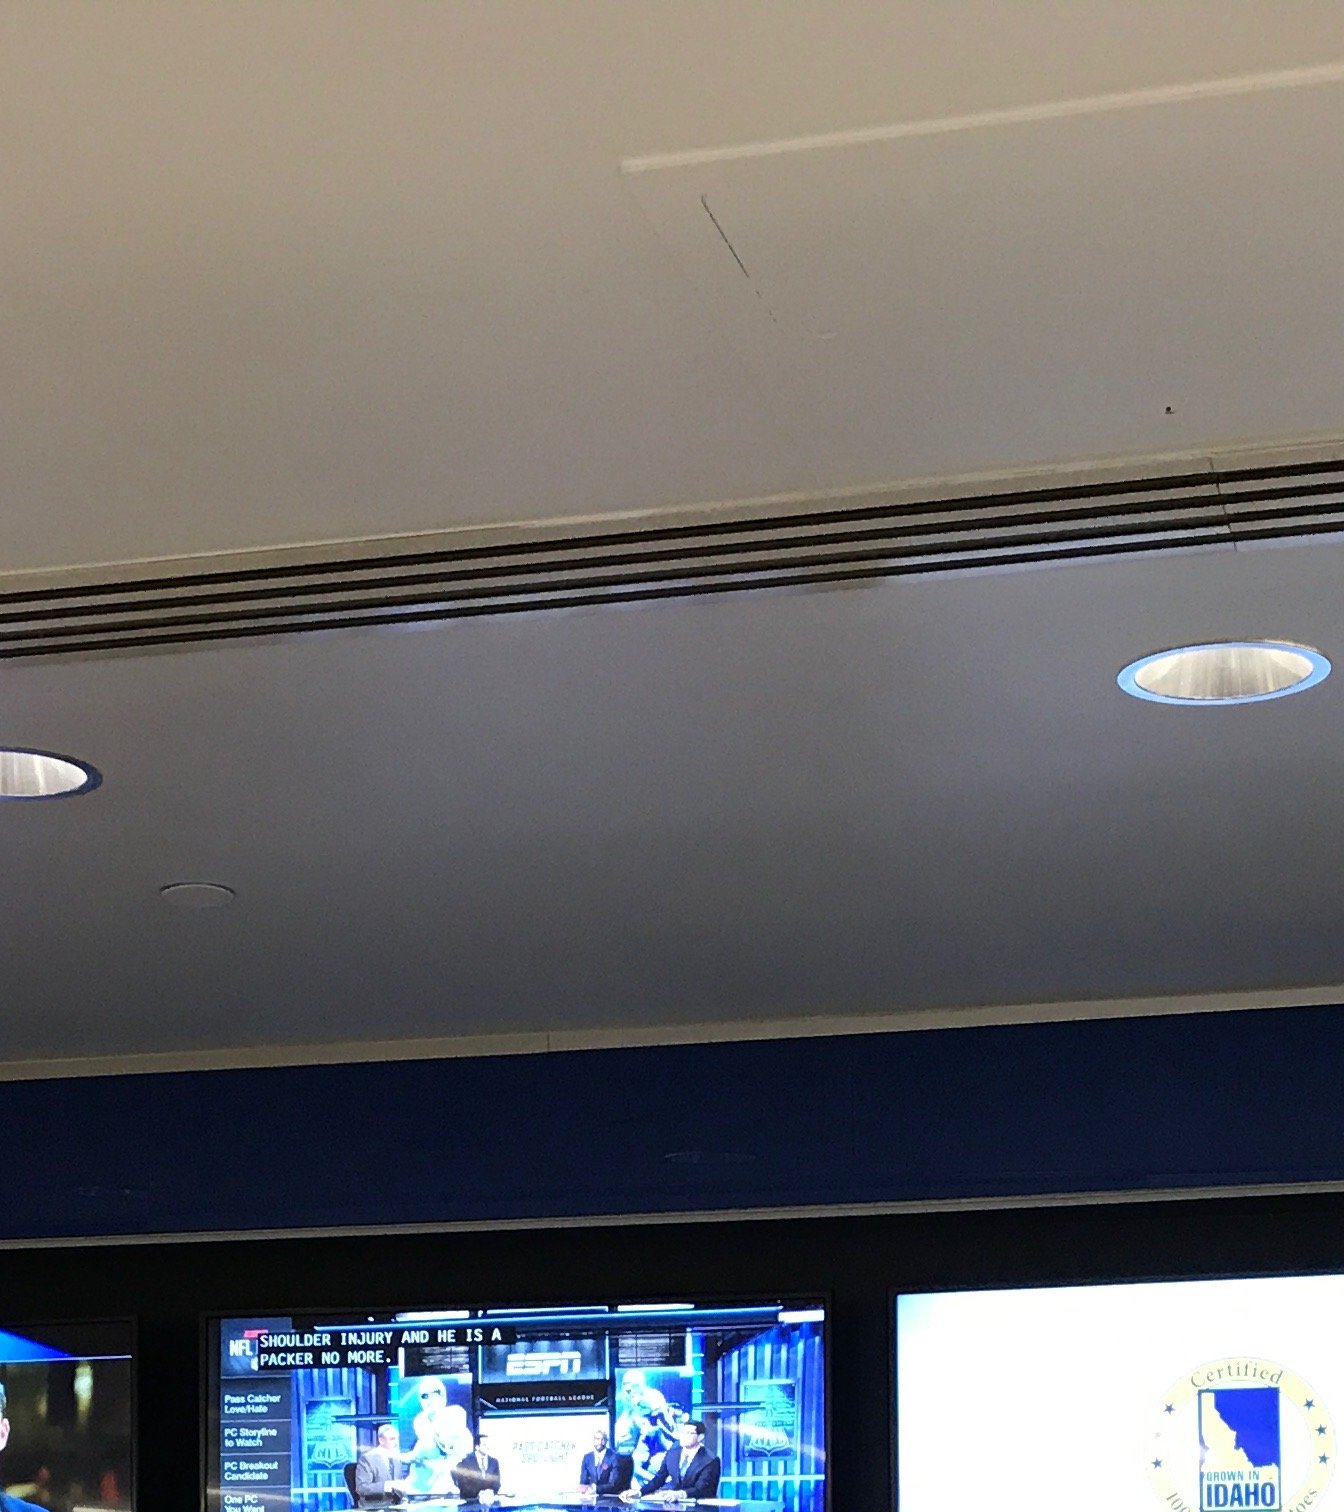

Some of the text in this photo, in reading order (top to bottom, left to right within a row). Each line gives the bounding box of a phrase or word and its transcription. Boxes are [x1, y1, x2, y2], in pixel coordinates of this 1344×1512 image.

[260, 1328, 502, 1348] SHOULDER INJURY AND HE IS A
[260, 1350, 392, 1367] PACKER NO MORE.
[506, 1351, 581, 1376] ESPN
[1190, 1361, 1284, 1389] Certified
[224, 1394, 246, 1404] Pass
[224, 1428, 238, 1437] PC
[235, 1438, 263, 1447] Watch
[224, 1461, 278, 1470] PC Breakout
[224, 1471, 269, 1481] Candidate
[1206, 1470, 1260, 1481] GROWN IN
[244, 1494, 258, 1503] PC
[1206, 1482, 1276, 1507] IDAHO
